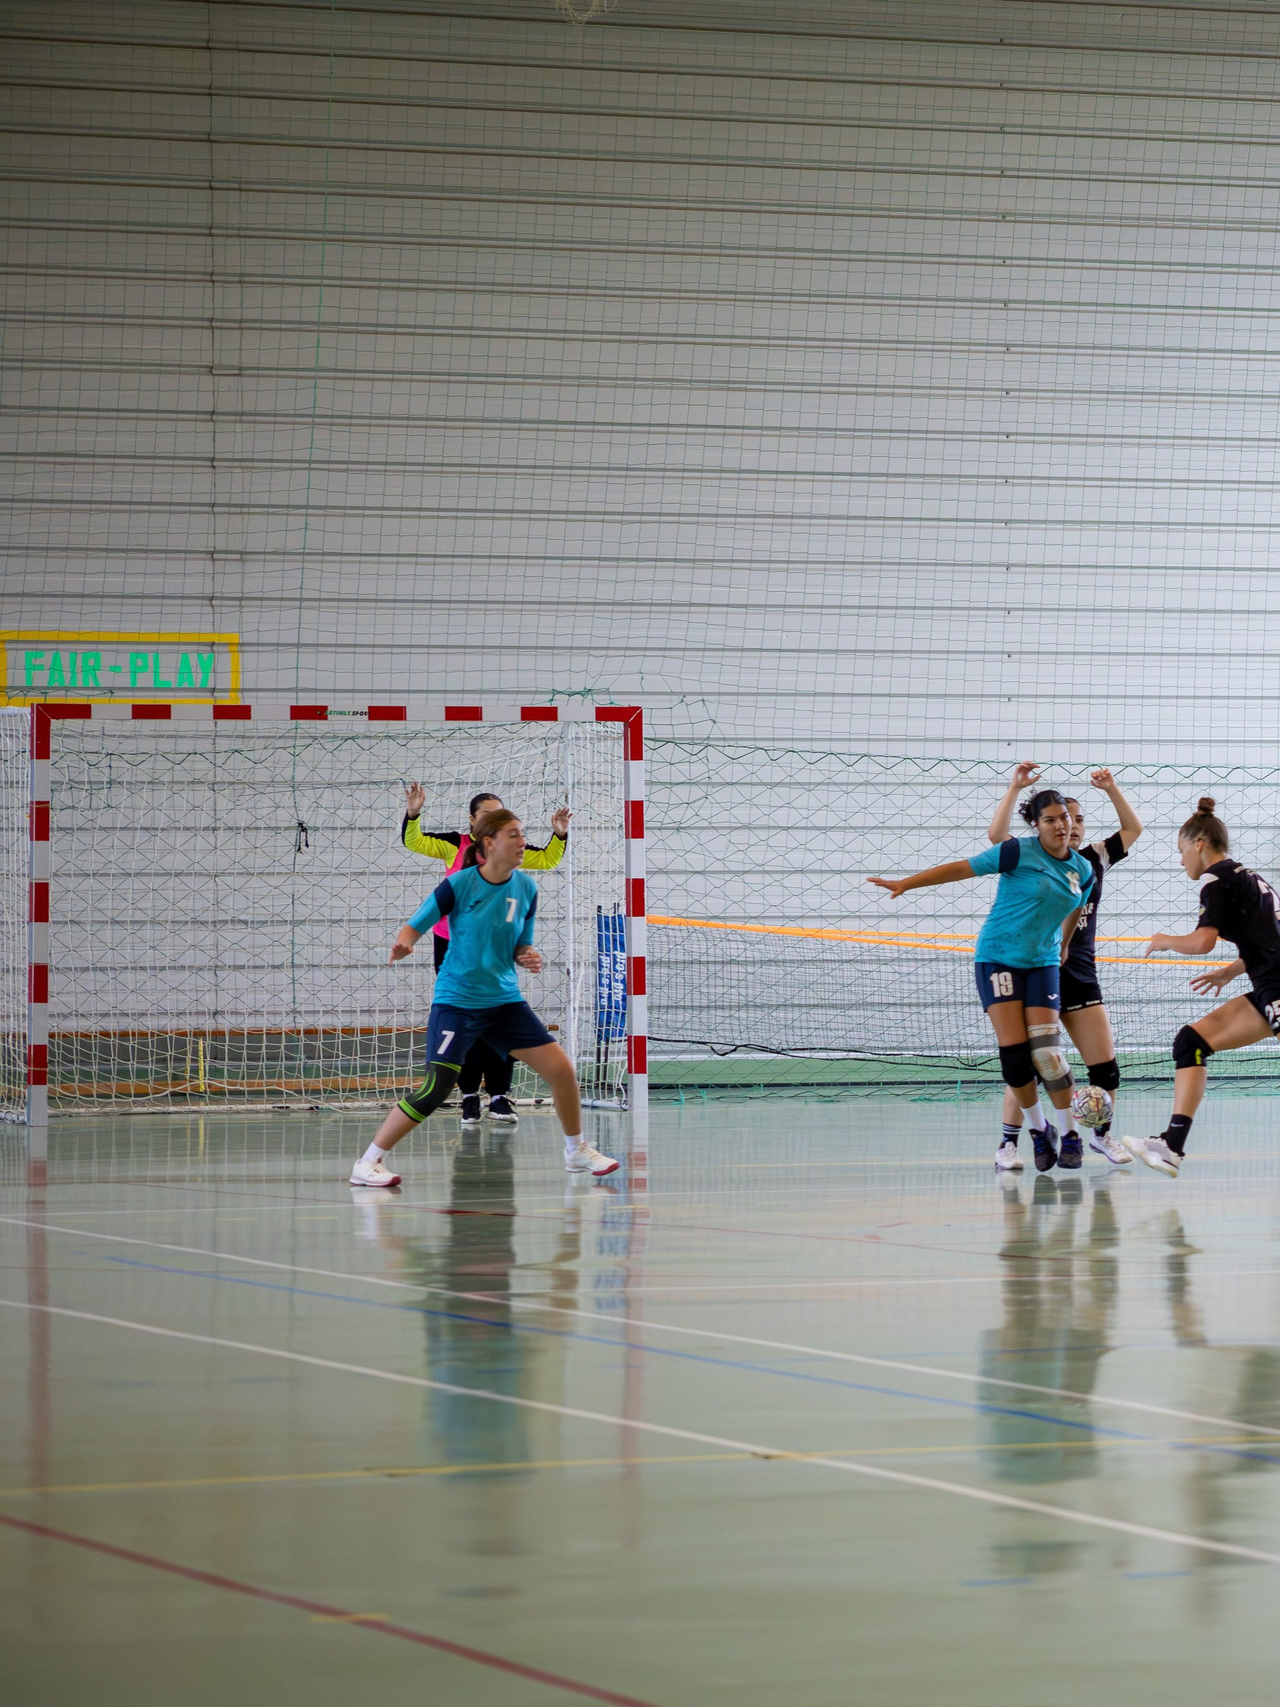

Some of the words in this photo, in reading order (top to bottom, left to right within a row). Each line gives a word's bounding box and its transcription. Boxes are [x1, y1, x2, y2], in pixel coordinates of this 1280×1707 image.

[25, 651, 214, 687] FAIR-PLAY
[505, 897, 517, 923] 7
[990, 971, 1014, 998] 19
[437, 1030, 455, 1055] 7
